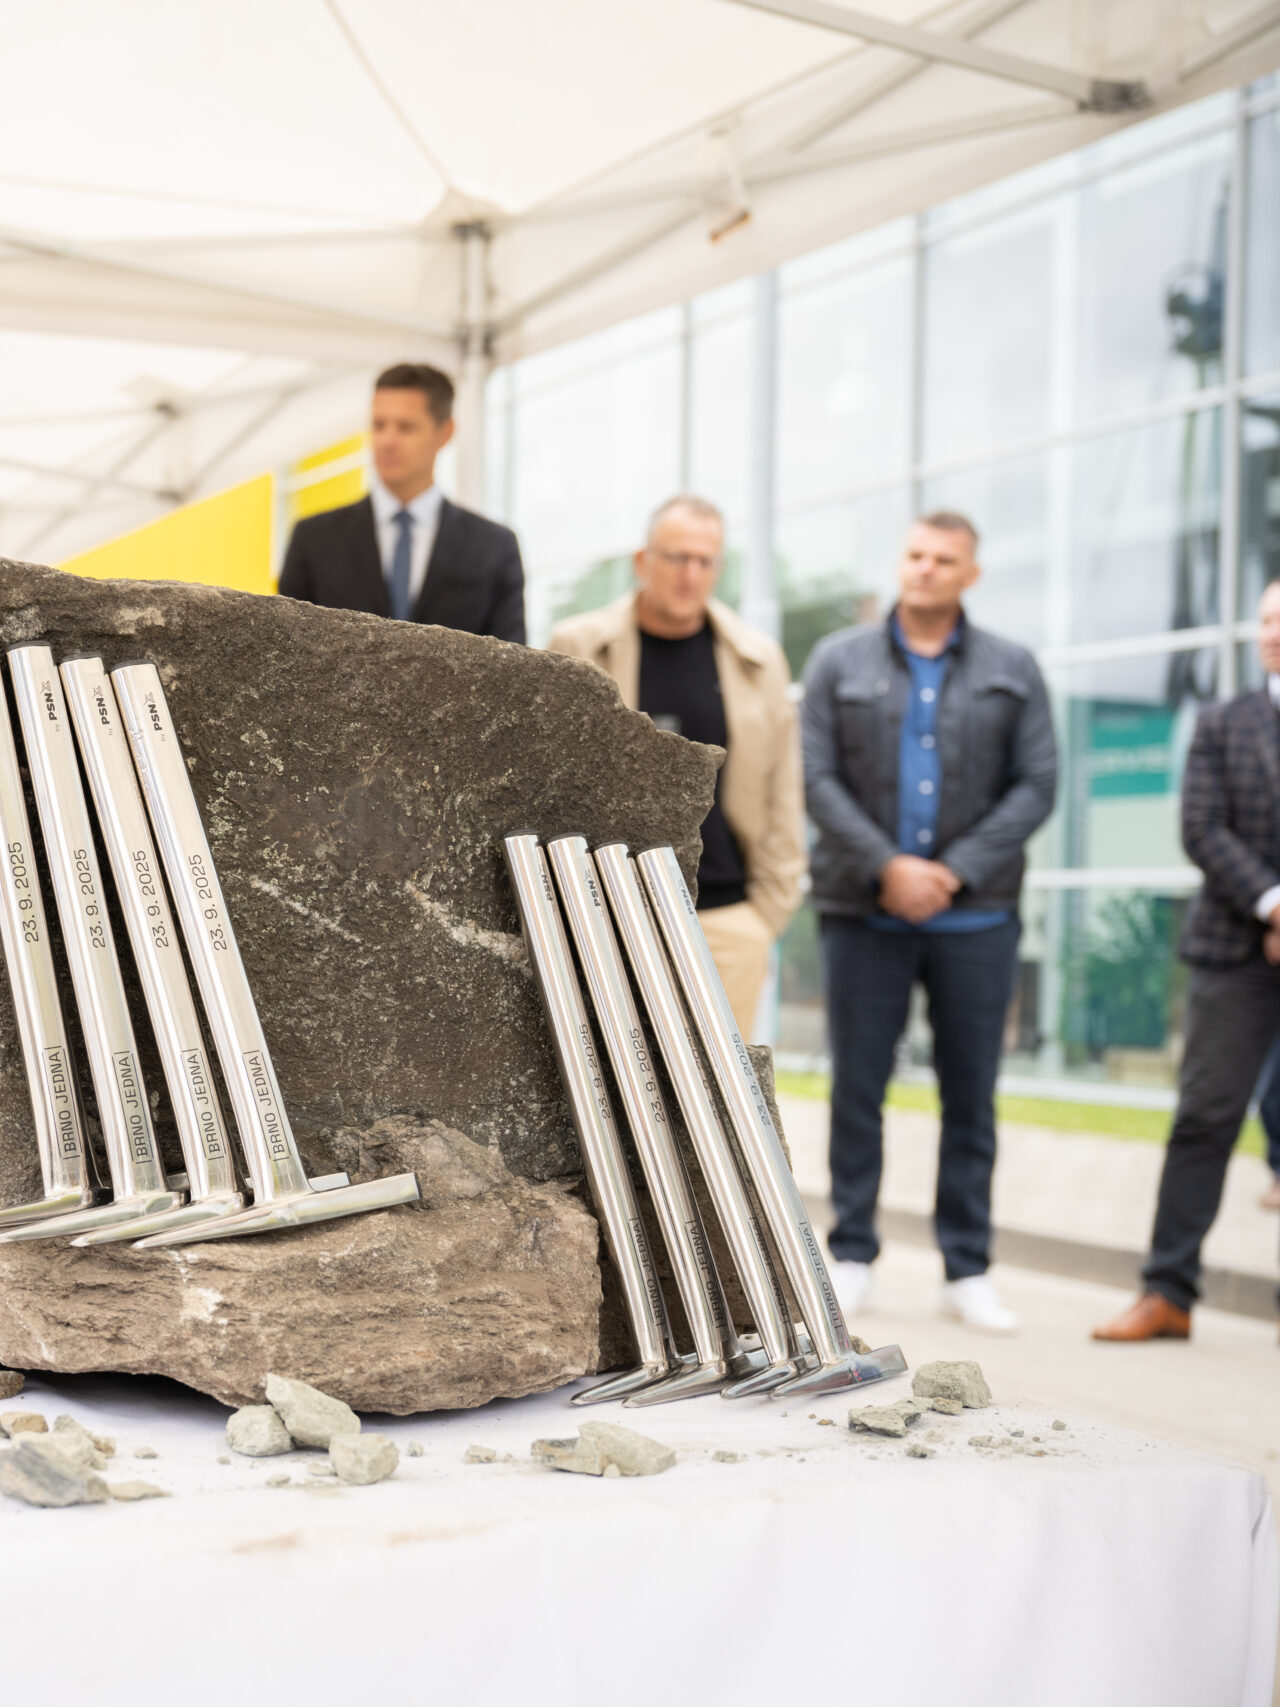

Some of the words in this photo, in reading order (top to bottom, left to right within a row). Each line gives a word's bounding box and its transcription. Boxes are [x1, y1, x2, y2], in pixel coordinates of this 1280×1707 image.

[44, 692, 58, 721] PSN
[96, 697, 110, 725] PSN
[148, 703, 163, 732] PSN
[540, 874, 553, 902] PSN
[587, 880, 601, 907] PSN
[681, 889, 694, 915] PSN
[47, 1051, 69, 1104] JEDNA
[118, 1055, 139, 1109] JEDNA
[187, 1053, 209, 1105] JEDNA
[249, 1055, 272, 1106] JEDNA
[58, 1111, 77, 1153] BRNO
[130, 1114, 148, 1158] BRNO
[201, 1111, 221, 1154] BRNO
[264, 1112, 285, 1155] BRNO
[690, 1226, 711, 1275] JEDNA
[803, 1227, 825, 1276] JEDNA
[706, 1281, 725, 1319] BRNO
[822, 1282, 841, 1320] BRNO
